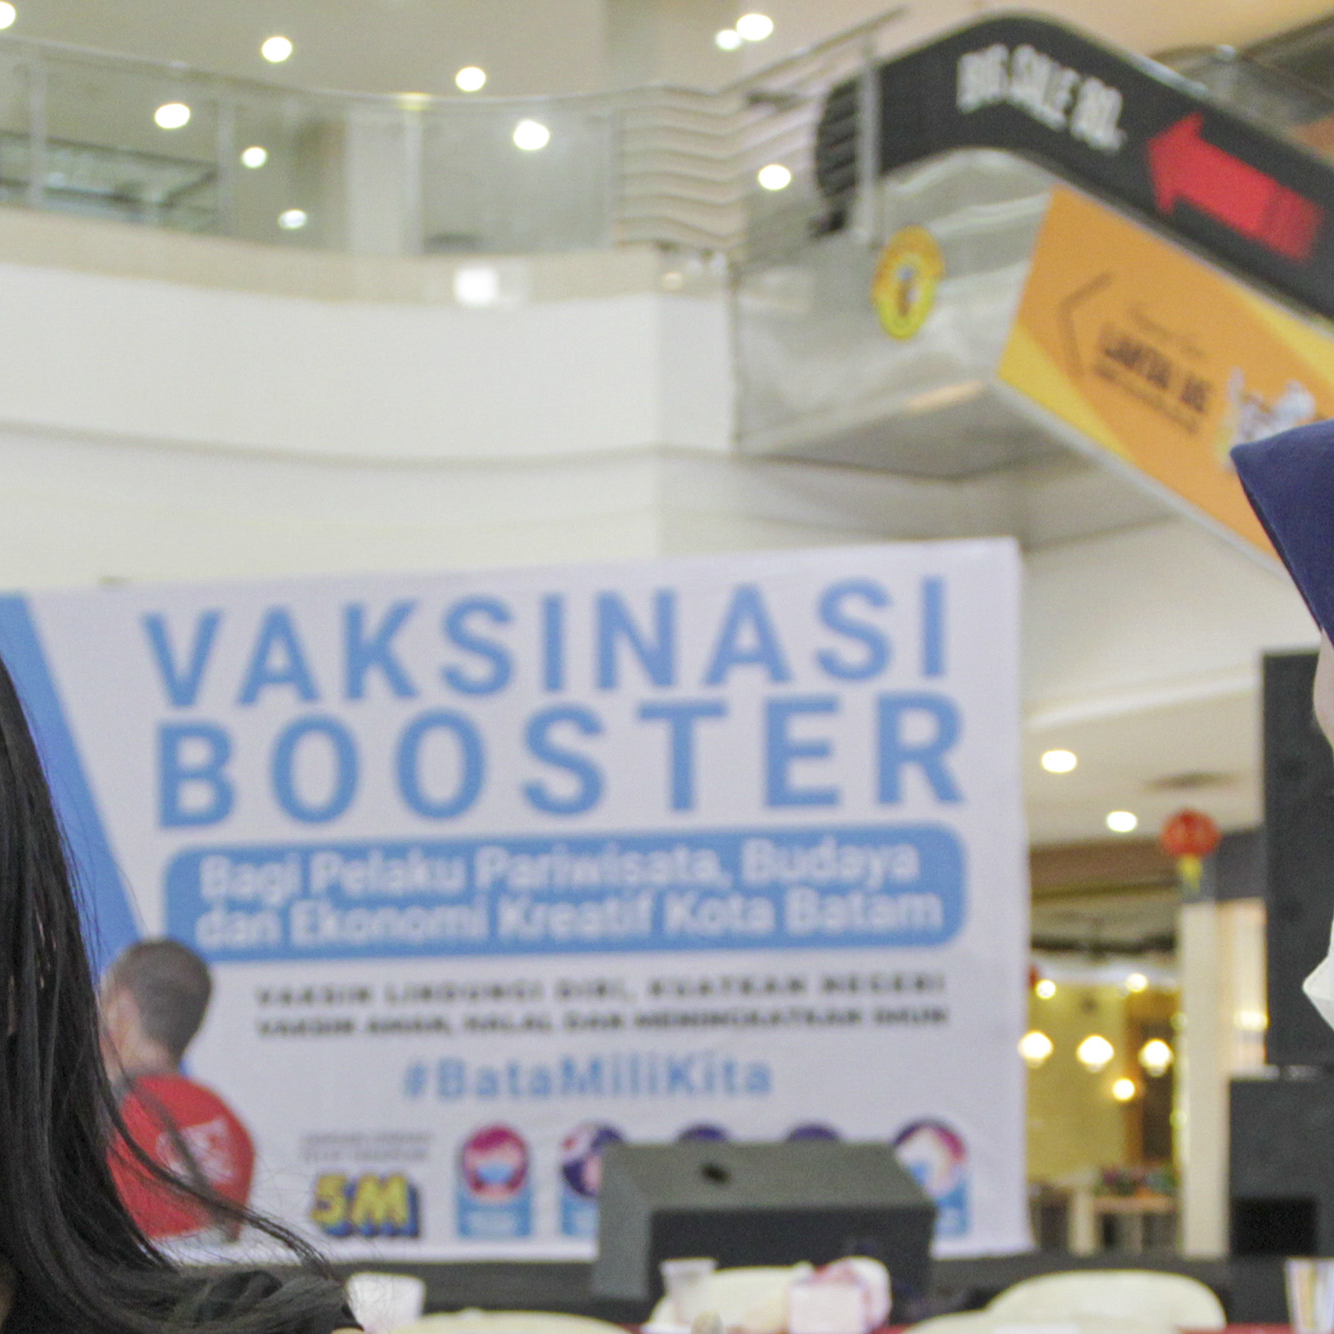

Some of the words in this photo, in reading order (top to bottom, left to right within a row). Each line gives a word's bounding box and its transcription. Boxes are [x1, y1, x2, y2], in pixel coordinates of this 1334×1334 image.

[141, 576, 946, 709] VAKSINASI
[155, 691, 967, 830] BOOSTER
[199, 852, 302, 908] Bagi
[309, 847, 466, 899] Pelaku
[474, 842, 733, 895] Pariwisata,
[741, 834, 921, 893] Budaya
[195, 901, 283, 951] dan
[288, 894, 490, 949] Ekonomi
[497, 886, 655, 945] Kreatif
[662, 889, 777, 938] Kota
[783, 885, 945, 937] Batam
[403, 1051, 773, 1102] #BataMiliKita
[311, 1170, 419, 1238] 5M
